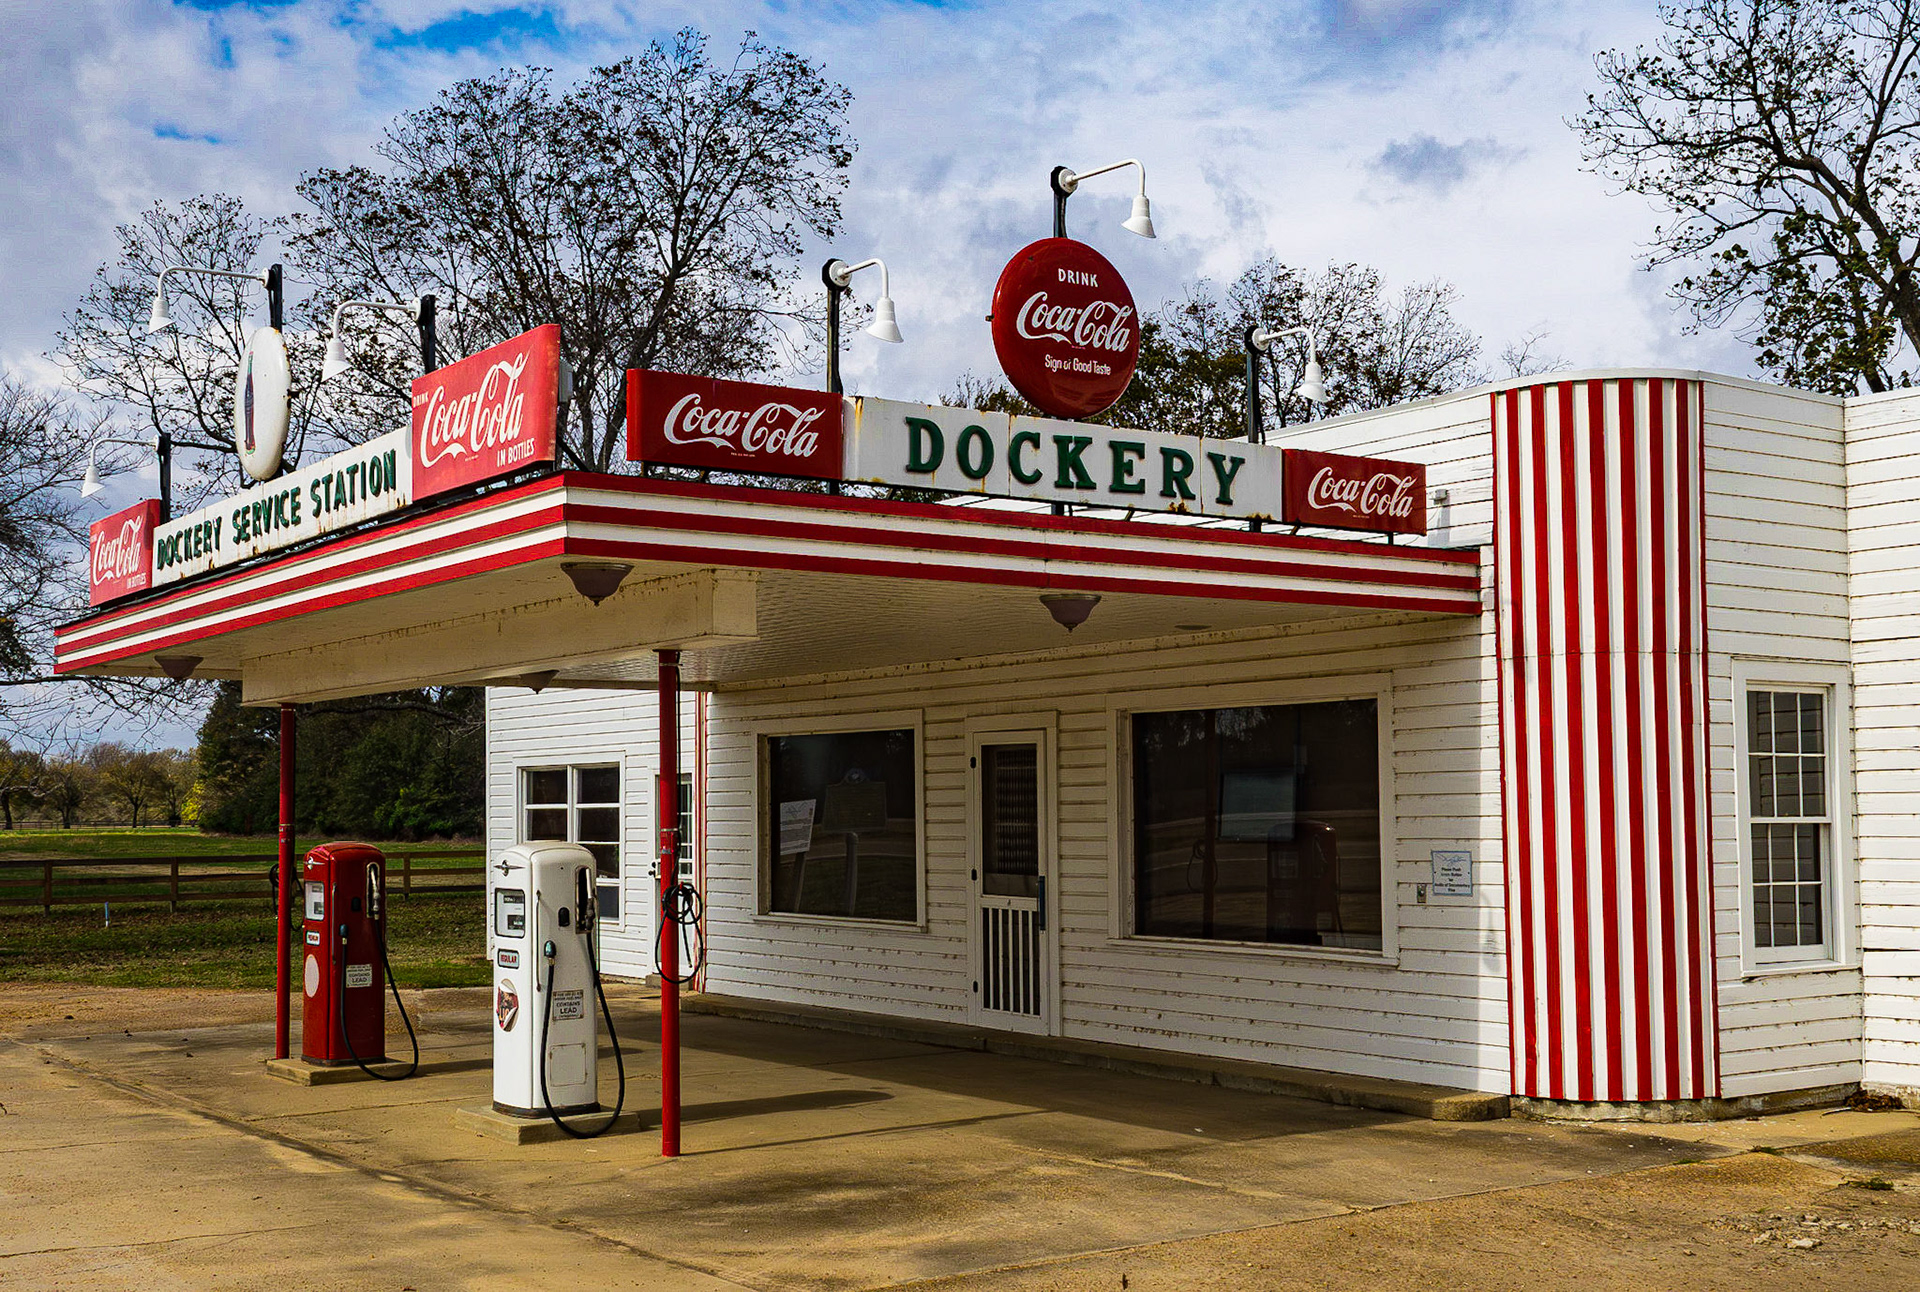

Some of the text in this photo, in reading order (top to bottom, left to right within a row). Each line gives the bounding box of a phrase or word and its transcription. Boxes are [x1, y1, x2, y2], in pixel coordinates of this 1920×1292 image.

[1057, 268, 1099, 288] DRINK
[1016, 291, 1133, 352] Coca-Cola
[1044, 353, 1063, 373] Sign
[1073, 357, 1092, 373] Good
[1093, 360, 1112, 376] Taste
[412, 391, 429, 408] DRINK
[420, 343, 535, 468] Coca-Cola
[663, 393, 826, 458] Coca-Cola
[496, 437, 535, 468] IN BOTTLES
[904, 416, 1246, 505] DOCKERY
[156, 448, 398, 571] DOCKERY SERVICE STATION
[1307, 466, 1418, 518] Coca-Cola
[92, 515, 144, 586] Coca-Cola
[560, 1007, 578, 1015] LEAD
